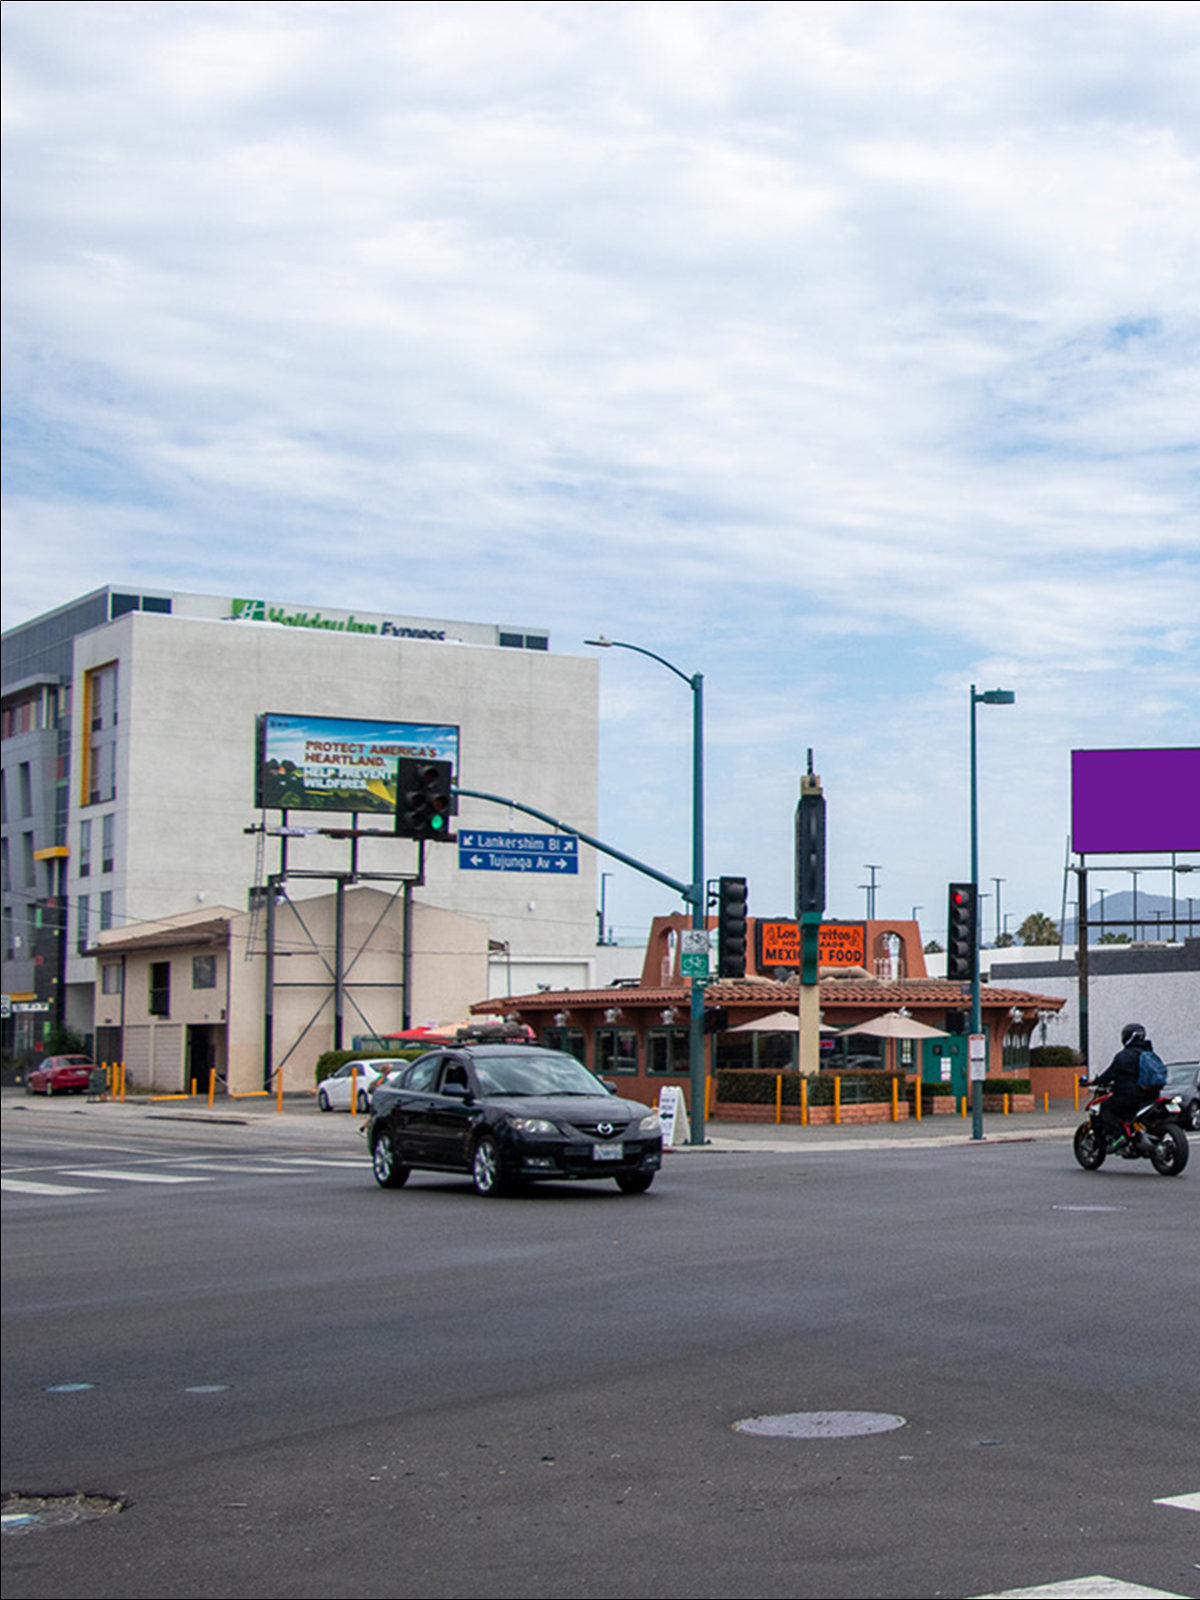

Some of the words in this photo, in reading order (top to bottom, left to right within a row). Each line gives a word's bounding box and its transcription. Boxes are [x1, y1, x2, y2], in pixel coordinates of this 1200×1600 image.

[305, 741, 366, 753] PROTECT
[369, 745, 437, 758] AMERICA'S
[304, 753, 387, 767] HEARTLAND.
[303, 767, 339, 778] HELP
[340, 768, 397, 780] PREVENT
[477, 835, 545, 850] Lankershim
[548, 838, 560, 851] Bl
[489, 854, 532, 871] Tujunga
[536, 857, 551, 869] Av
[777, 926, 797, 939] Los
[765, 948, 823, 961] MEXI
[828, 950, 862, 962] FOOD
